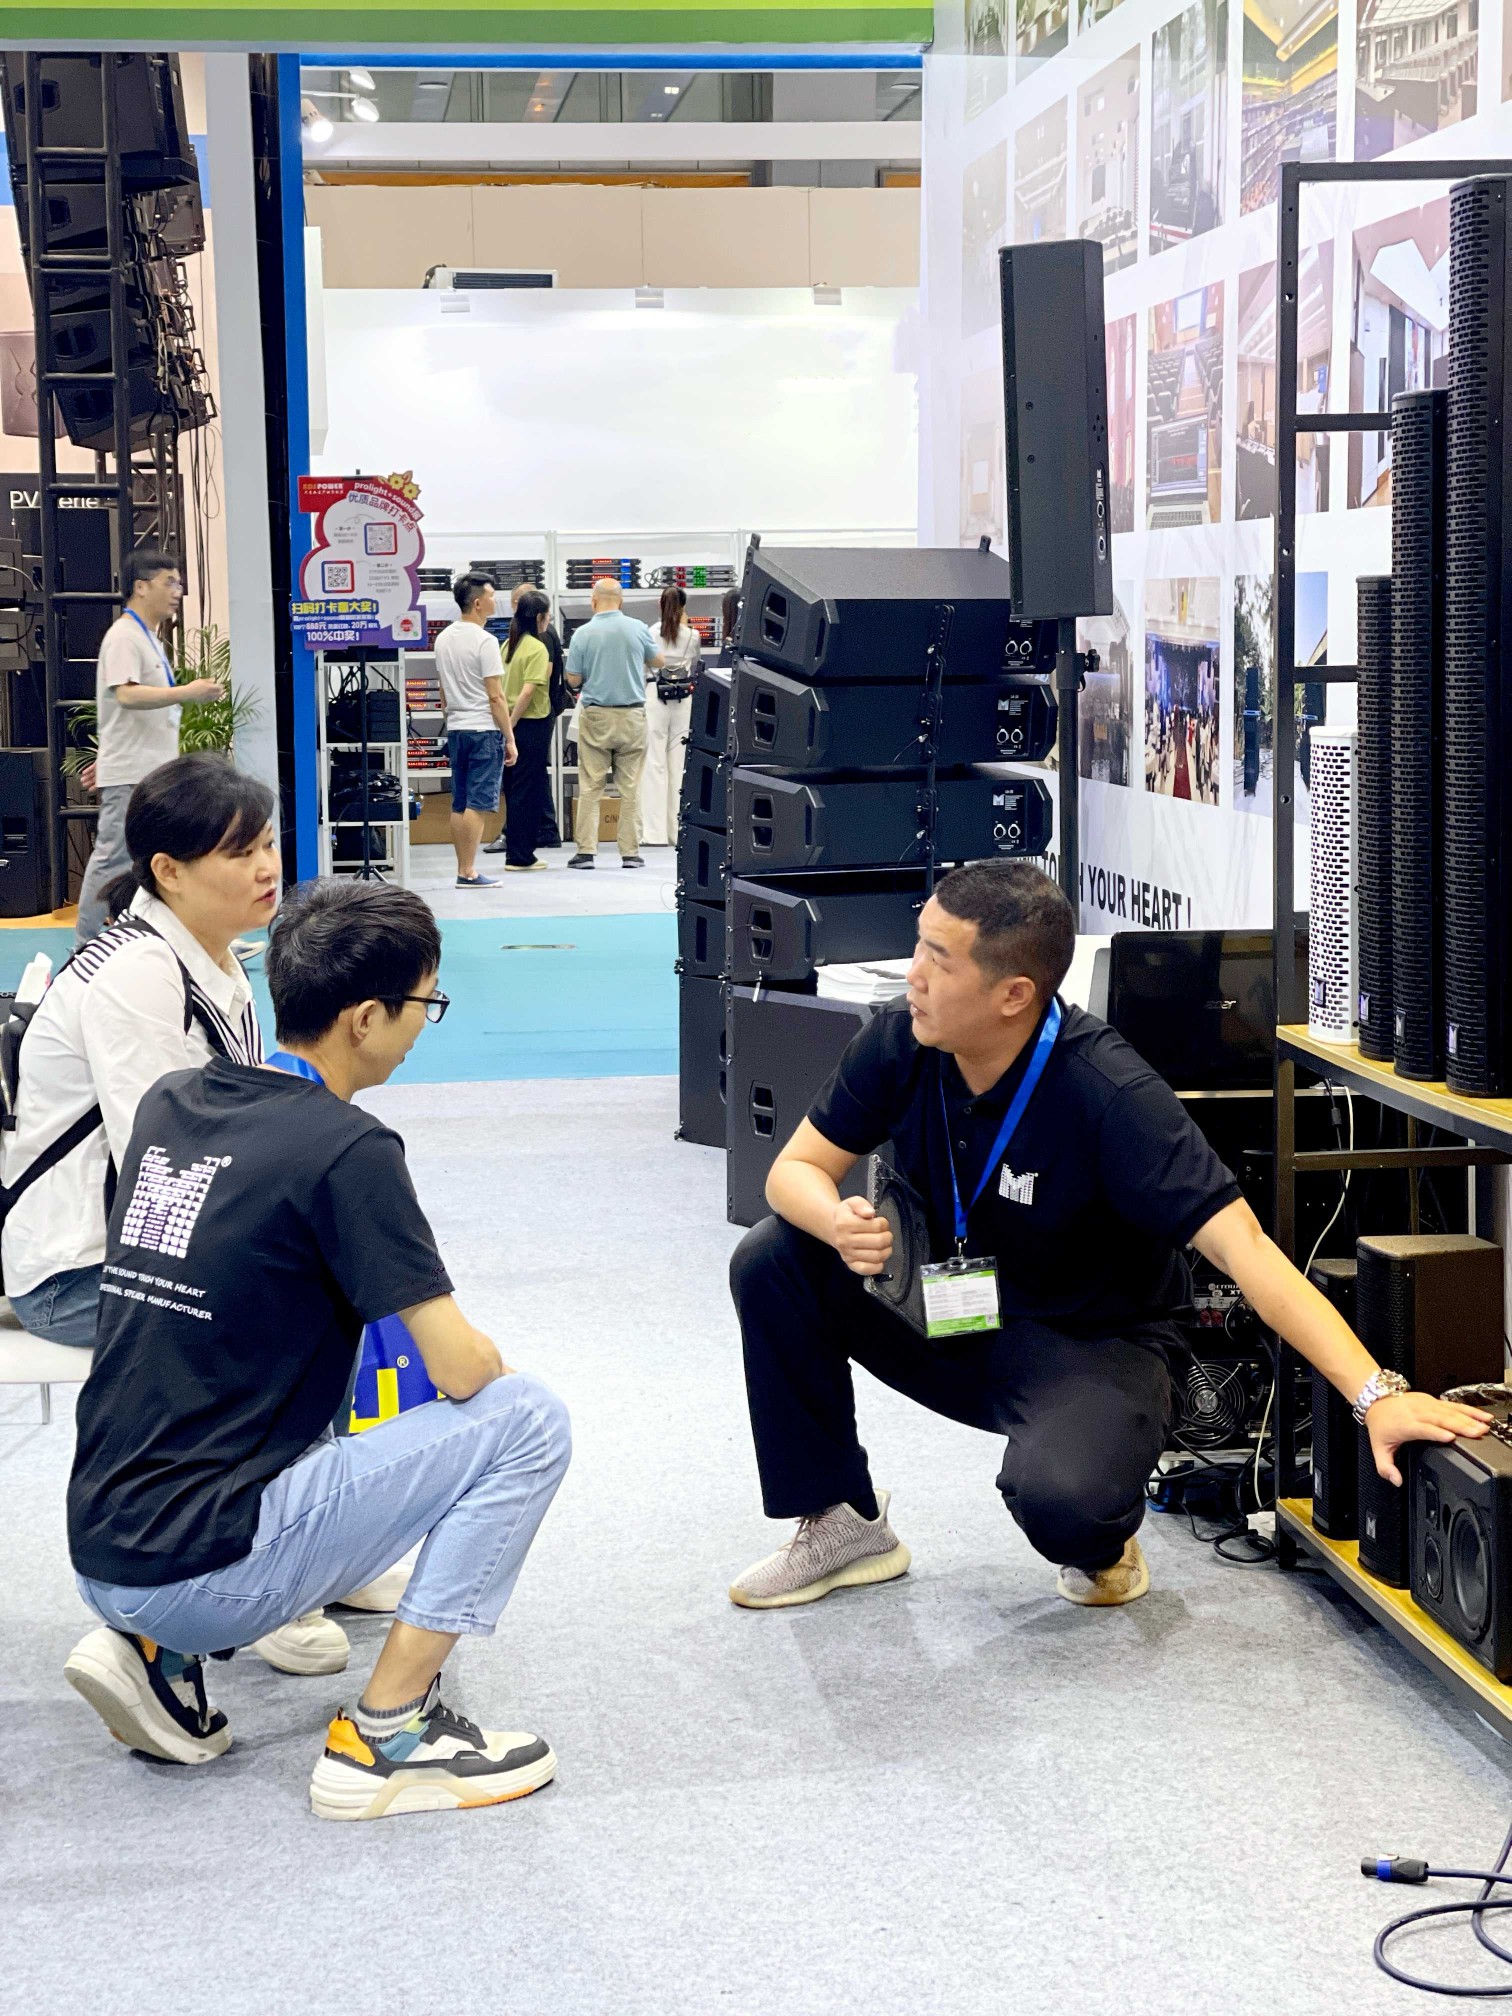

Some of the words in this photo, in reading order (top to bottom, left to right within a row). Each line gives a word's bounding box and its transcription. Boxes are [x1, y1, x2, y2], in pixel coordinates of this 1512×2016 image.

[9, 490, 39, 508] PV
[348, 492, 416, 533] 优质品牌打卡点
[1087, 864, 1127, 918] YOUR
[1131, 878, 1182, 931] HEART
[155, 1276, 173, 1289] YOUR
[174, 1283, 206, 1299] HEART
[147, 1294, 213, 1321] MANUFACTURER
